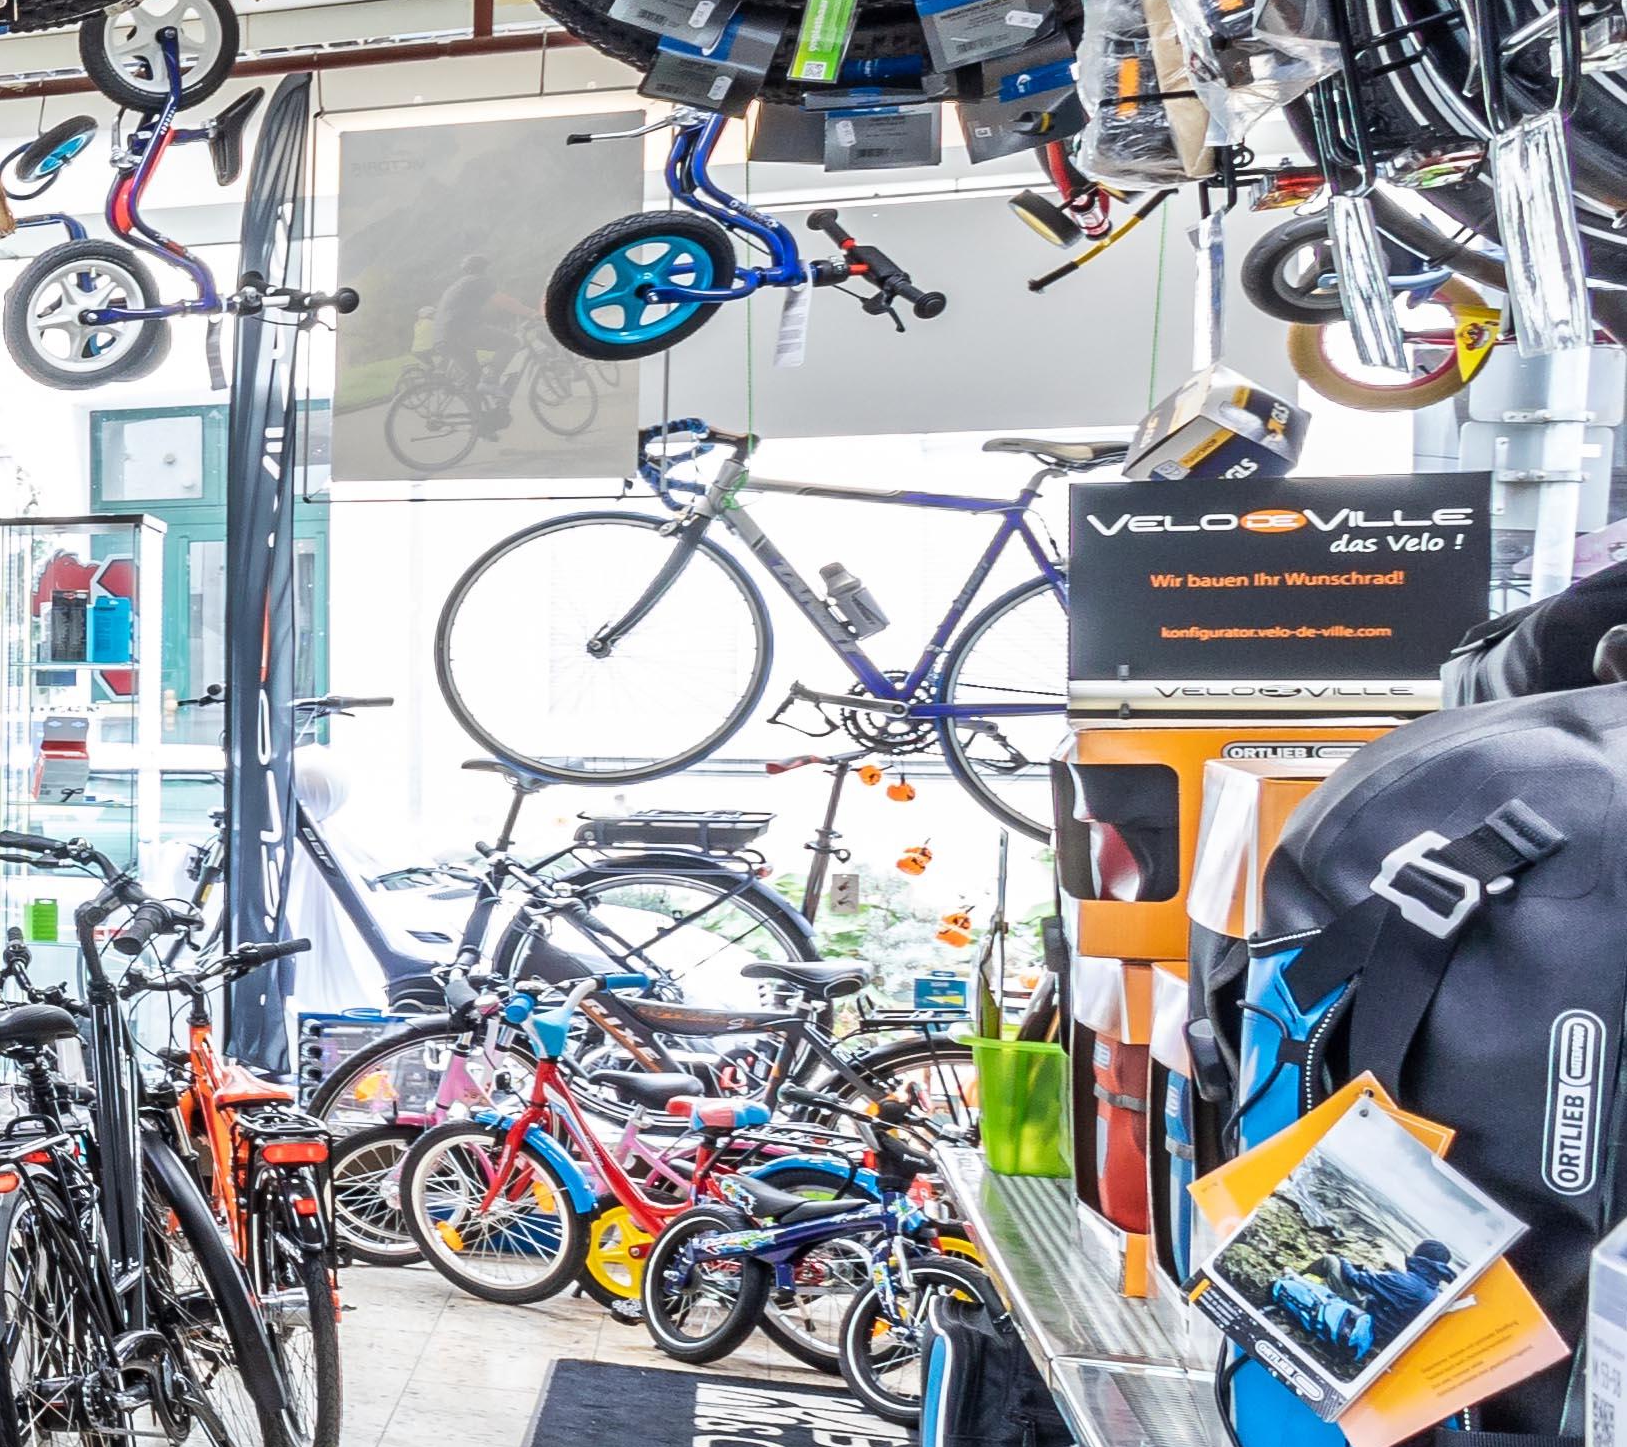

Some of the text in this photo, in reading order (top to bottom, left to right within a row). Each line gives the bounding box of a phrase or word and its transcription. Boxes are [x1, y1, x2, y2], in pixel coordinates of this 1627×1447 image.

[1087, 511, 1240, 536] VELO
[1302, 507, 1474, 533] VILLE
[1330, 534, 1378, 554] das
[1386, 534, 1444, 553] Velo
[1150, 571, 1405, 588] Wir bauen Ihr Wunschrad!
[1160, 625, 1392, 642] konfigurator.velo-de-ville.com
[1154, 685, 1415, 699] VELO VILLE
[1229, 746, 1308, 760] ORTLIEB
[581, 998, 663, 1066] RIXE
[1559, 1092, 1587, 1185] ORTLIEB
